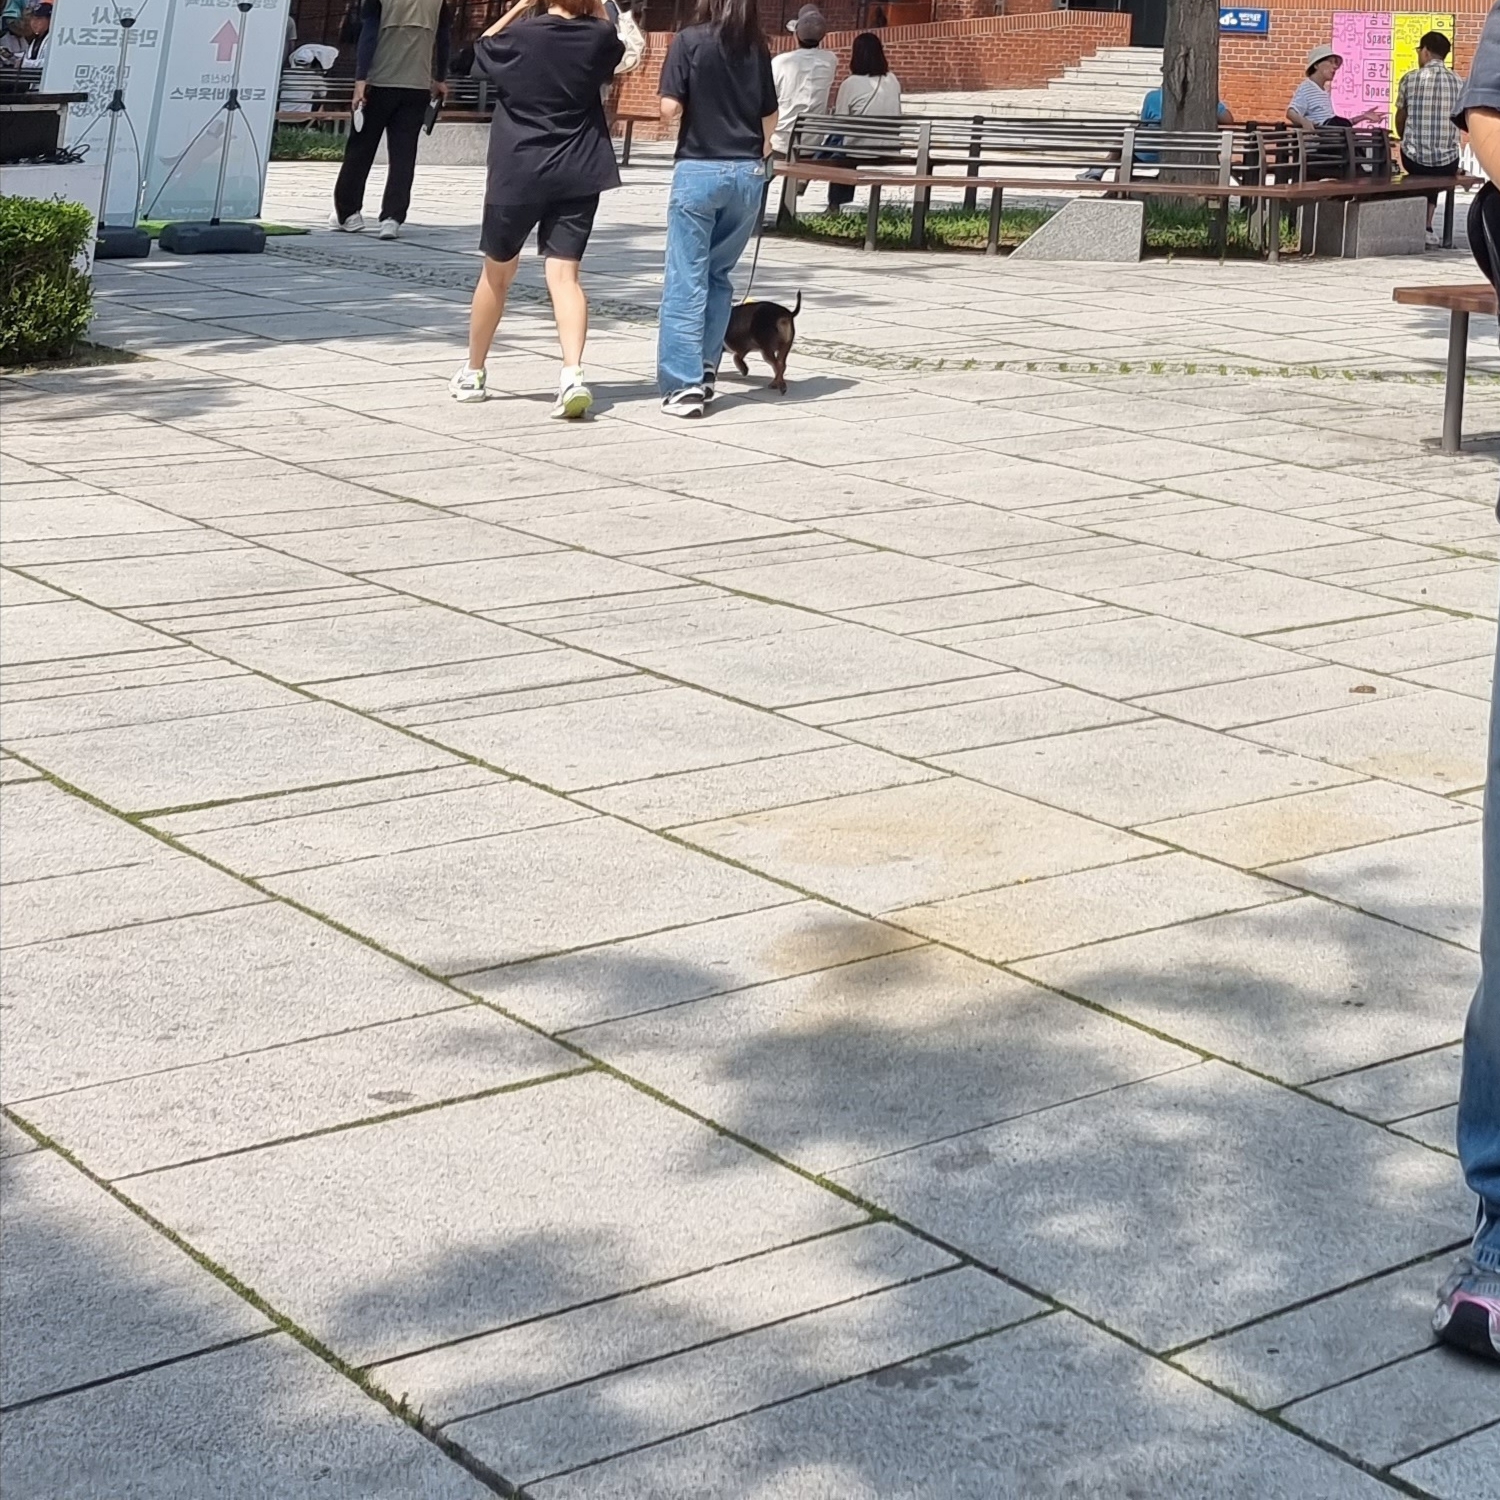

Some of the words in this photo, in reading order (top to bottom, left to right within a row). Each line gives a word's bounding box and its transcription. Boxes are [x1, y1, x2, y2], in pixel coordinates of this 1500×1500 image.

[1366, 32, 1392, 46] Space
[1367, 62, 1390, 78] 공간
[1365, 84, 1390, 98] Space
